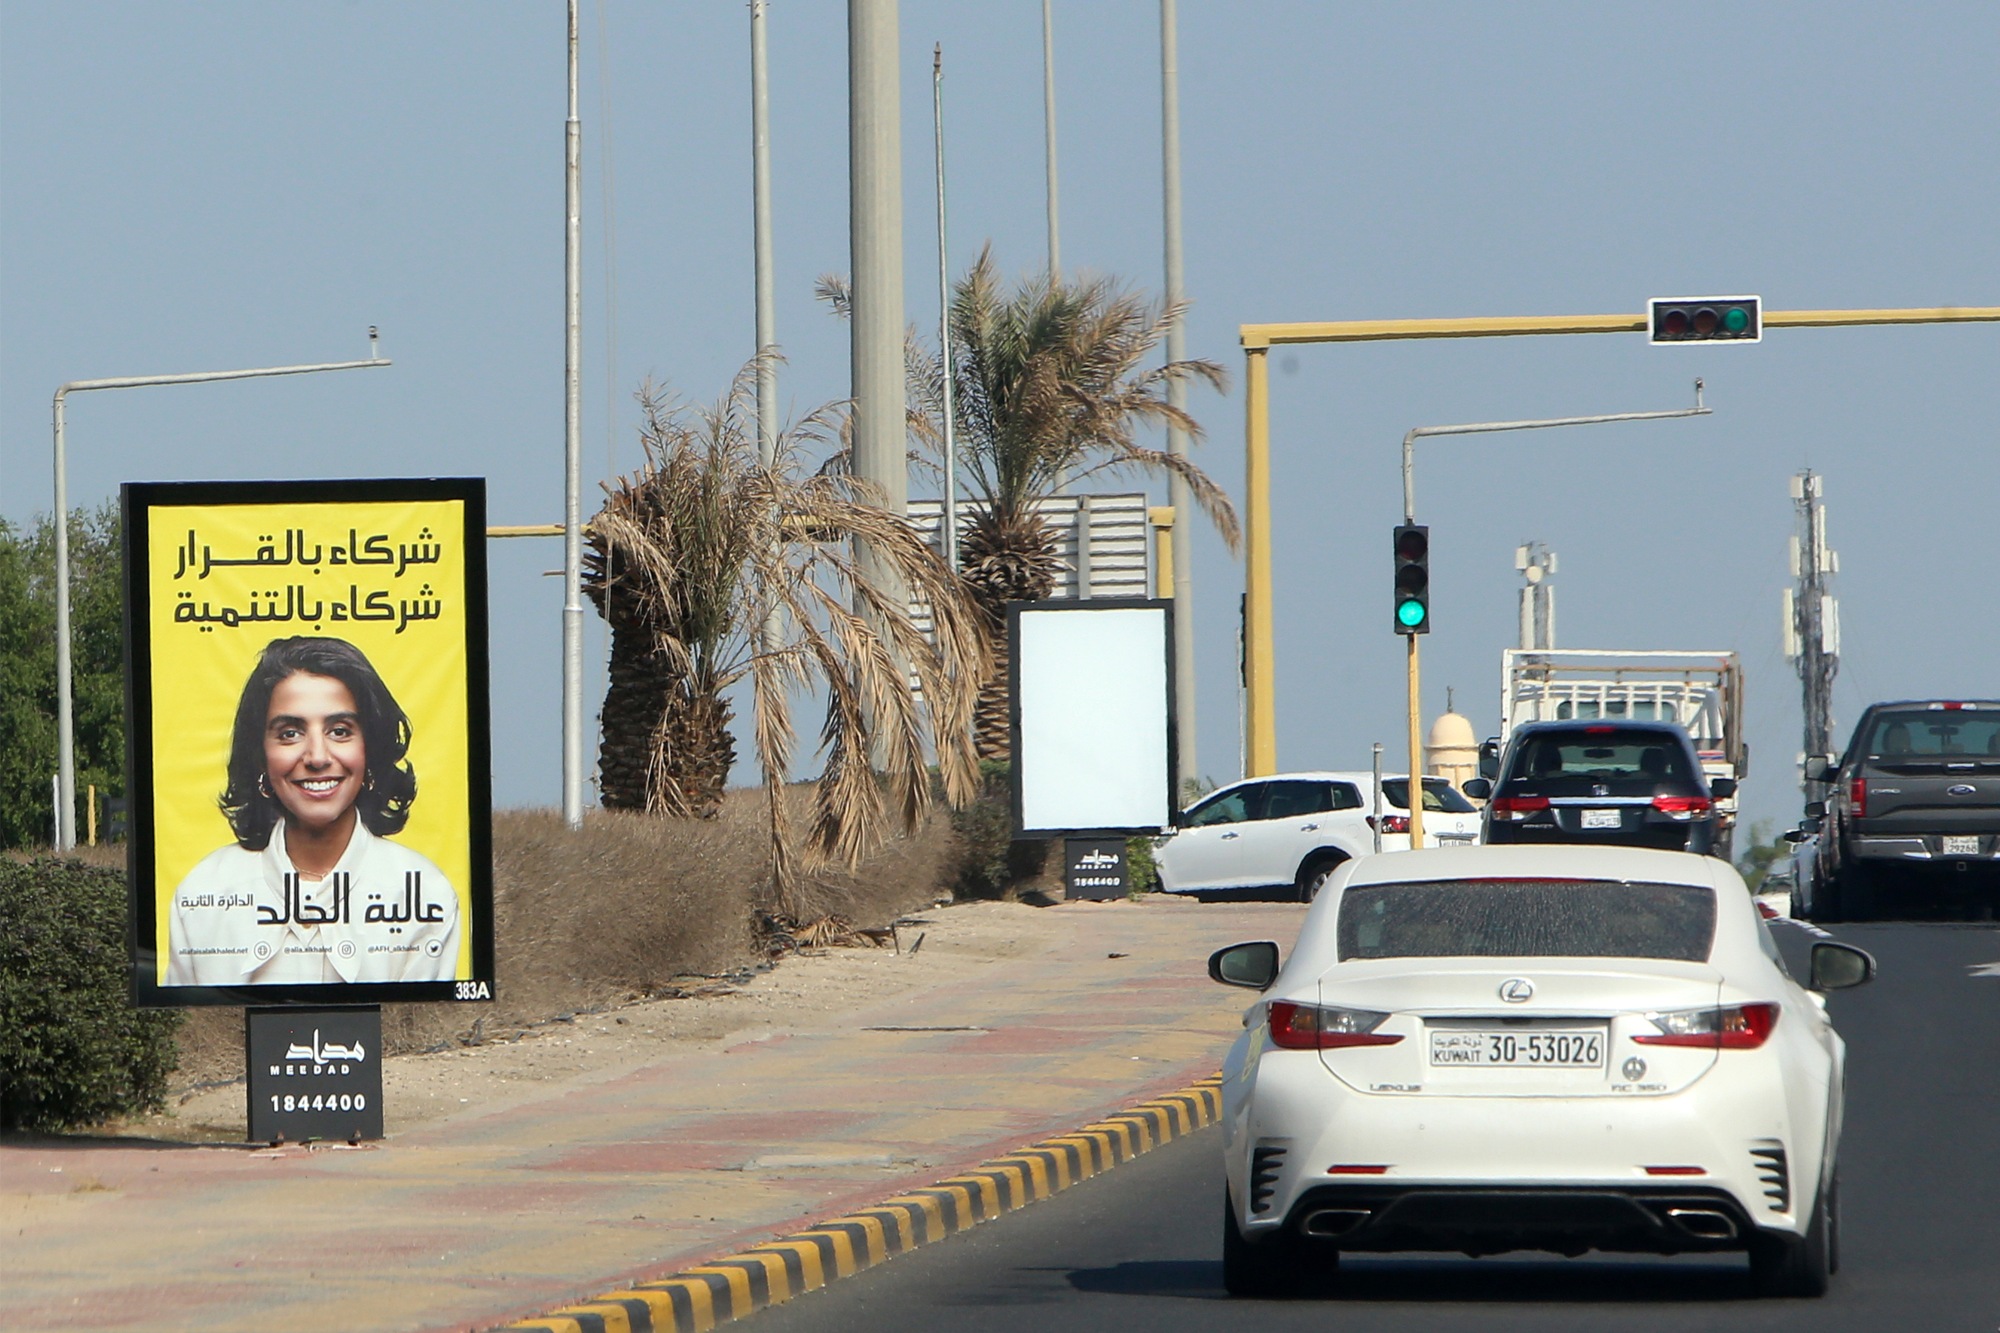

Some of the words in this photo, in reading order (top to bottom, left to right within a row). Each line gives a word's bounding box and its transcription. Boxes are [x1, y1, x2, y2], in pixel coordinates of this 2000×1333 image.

[330, 527, 441, 578] شركاء
[174, 585, 323, 632] بالتنمية
[330, 584, 442, 634] شركاء
[181, 894, 214, 911] الثانية
[217, 894, 254, 911] الدائرة
[257, 872, 350, 925] الخالد
[365, 871, 444, 934] عالية
[455, 982, 491, 1000] 383A
[1434, 1050, 1481, 1063] KUWAIT
[1489, 1035, 1599, 1063] 30-53026
[270, 1064, 350, 1076] MEEDAD
[270, 1093, 366, 1113] 1844400
